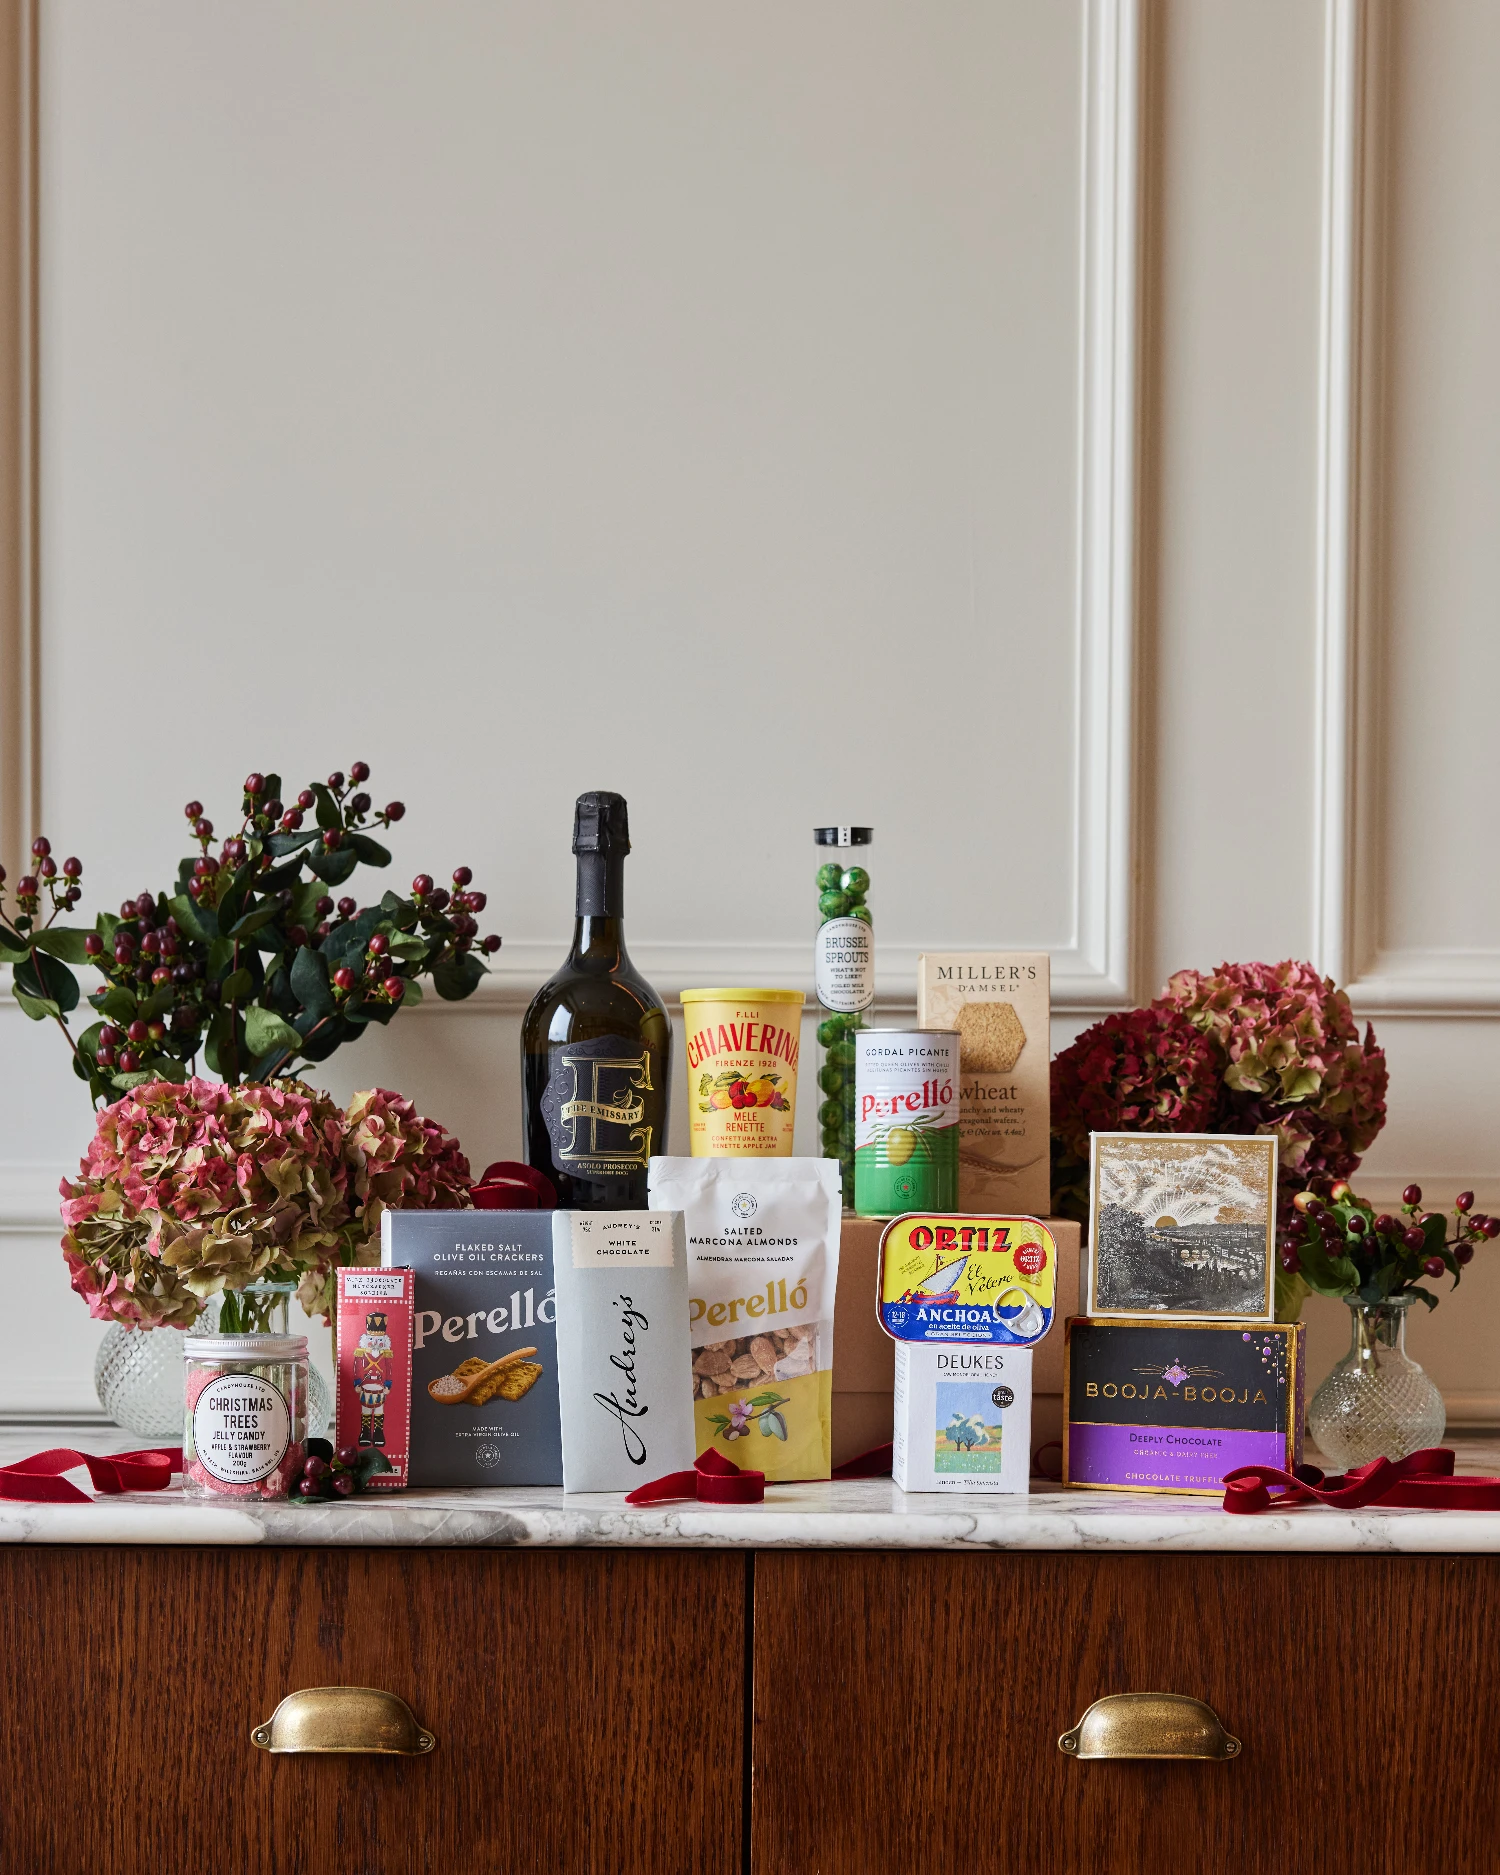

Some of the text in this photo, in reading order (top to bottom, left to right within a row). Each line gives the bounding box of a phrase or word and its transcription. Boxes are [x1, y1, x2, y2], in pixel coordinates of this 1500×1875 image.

[825, 937, 869, 949] BRUSSEL
[825, 951, 869, 963] SPROUTS
[937, 966, 1037, 980] MILLER'S
[736, 1011, 759, 1019] F.LLI
[687, 1022, 798, 1070] CHIAVERINI
[866, 1048, 950, 1057] GORDAL PICANTE
[758, 1060, 777, 1068] 1928
[960, 1080, 1018, 1100] wheat
[862, 1078, 953, 1123] Perelló
[565, 1104, 640, 1121] THE EMISSARY
[733, 1111, 758, 1121] MELE
[998, 1106, 1025, 1116] wheaty
[960, 1116, 992, 1126] exagonal
[725, 1122, 765, 1132] RENETTE
[603, 1223, 641, 1231] AUDREY'S
[724, 1228, 763, 1236] SALTED
[689, 1236, 798, 1246] MARCONA ALMONDS
[908, 1225, 1013, 1253] ORTIZ
[456, 1243, 522, 1252] FLAKED SALT
[433, 1253, 544, 1261] OLIVE OIL CRACKERS
[413, 1287, 556, 1350] Perelló
[937, 1354, 1004, 1370] DEUKES
[593, 1294, 649, 1466] Audrey's
[1086, 1382, 1268, 1405] BOOJA-BOOJA
[209, 1397, 273, 1412] CHRISTMAS
[223, 1414, 259, 1429] TREES
[212, 1431, 266, 1440] JELLY CANDY
[228, 1443, 233, 1451] &
[234, 1443, 271, 1451] STRAWBERRY
[232, 1460, 247, 1468] 200g
[1125, 1472, 1224, 1485] CHOCOLATE TRUFFLE
